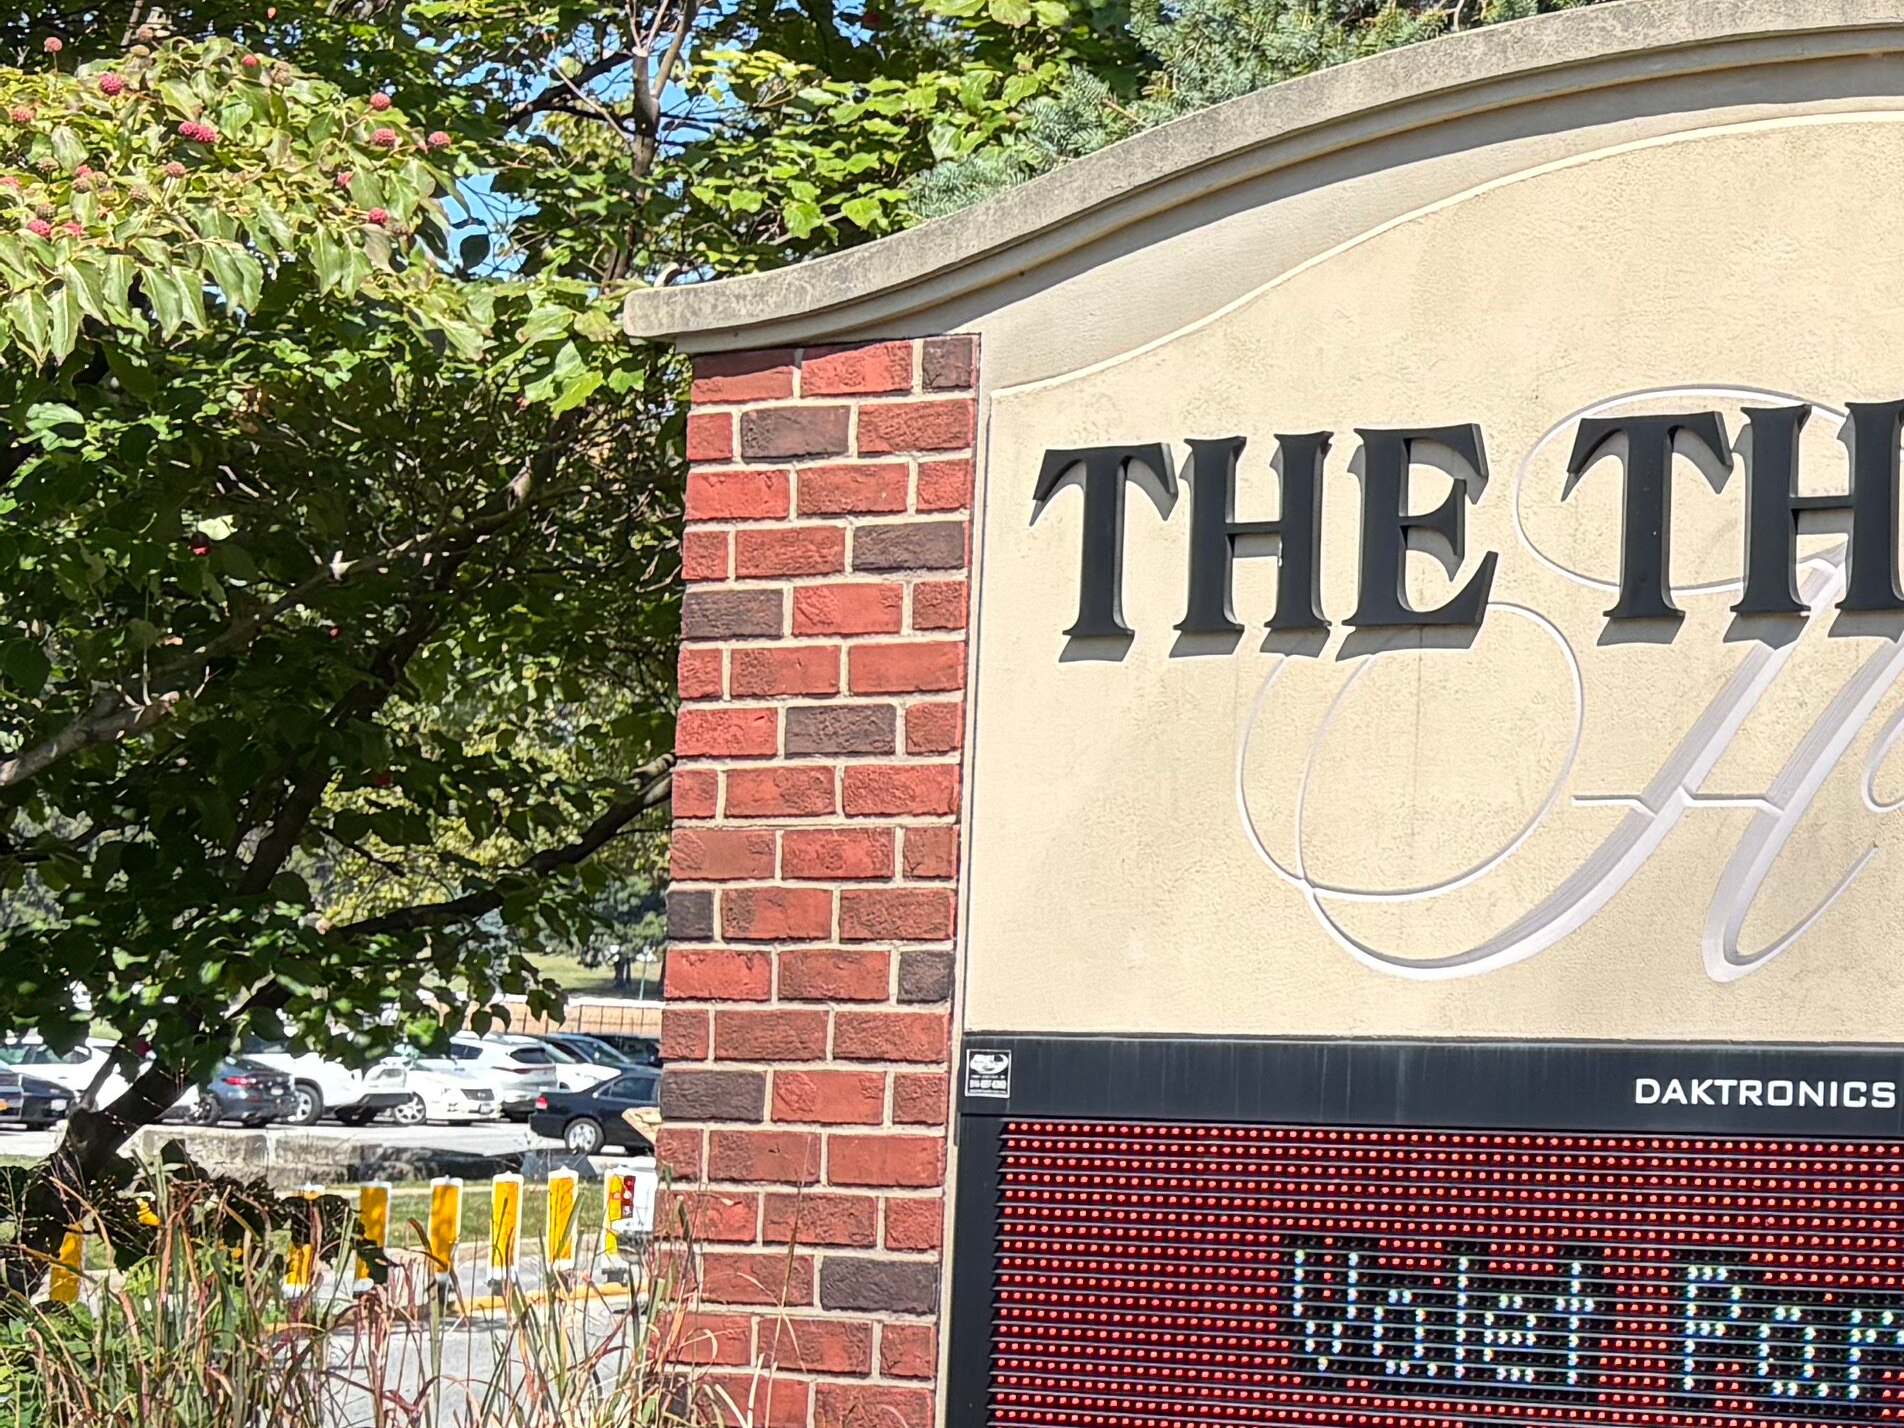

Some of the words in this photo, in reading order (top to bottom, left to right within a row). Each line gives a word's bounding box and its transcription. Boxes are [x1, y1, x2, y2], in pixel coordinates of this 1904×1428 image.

[1033, 423, 1500, 636] THE
[1635, 1078, 1896, 1108] DAKTRONICS
[1292, 1248, 1596, 1387] Valet
